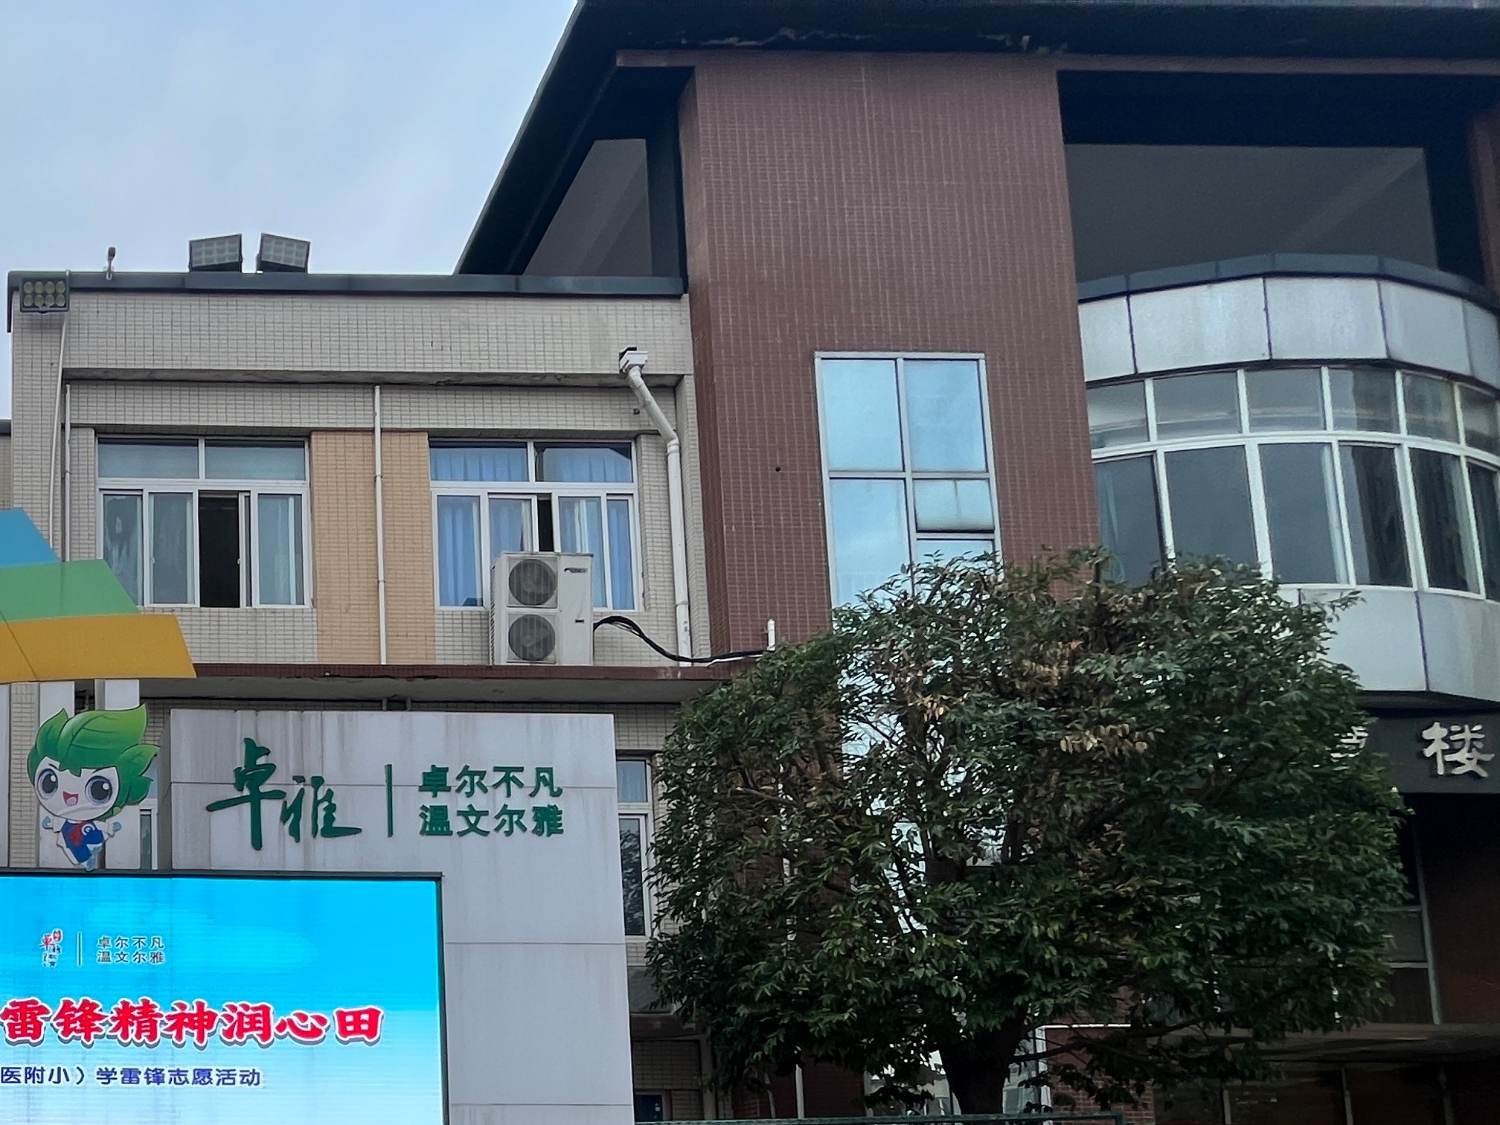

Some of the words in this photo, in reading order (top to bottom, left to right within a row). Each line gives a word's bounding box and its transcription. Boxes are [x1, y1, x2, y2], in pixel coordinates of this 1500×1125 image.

[206, 737, 362, 851] 卓雅
[418, 764, 563, 800] 卓尔不凡
[418, 804, 565, 838] 温文尔雅
[97, 937, 164, 949] 卓尔不凡
[97, 951, 164, 963] 温文尔雅
